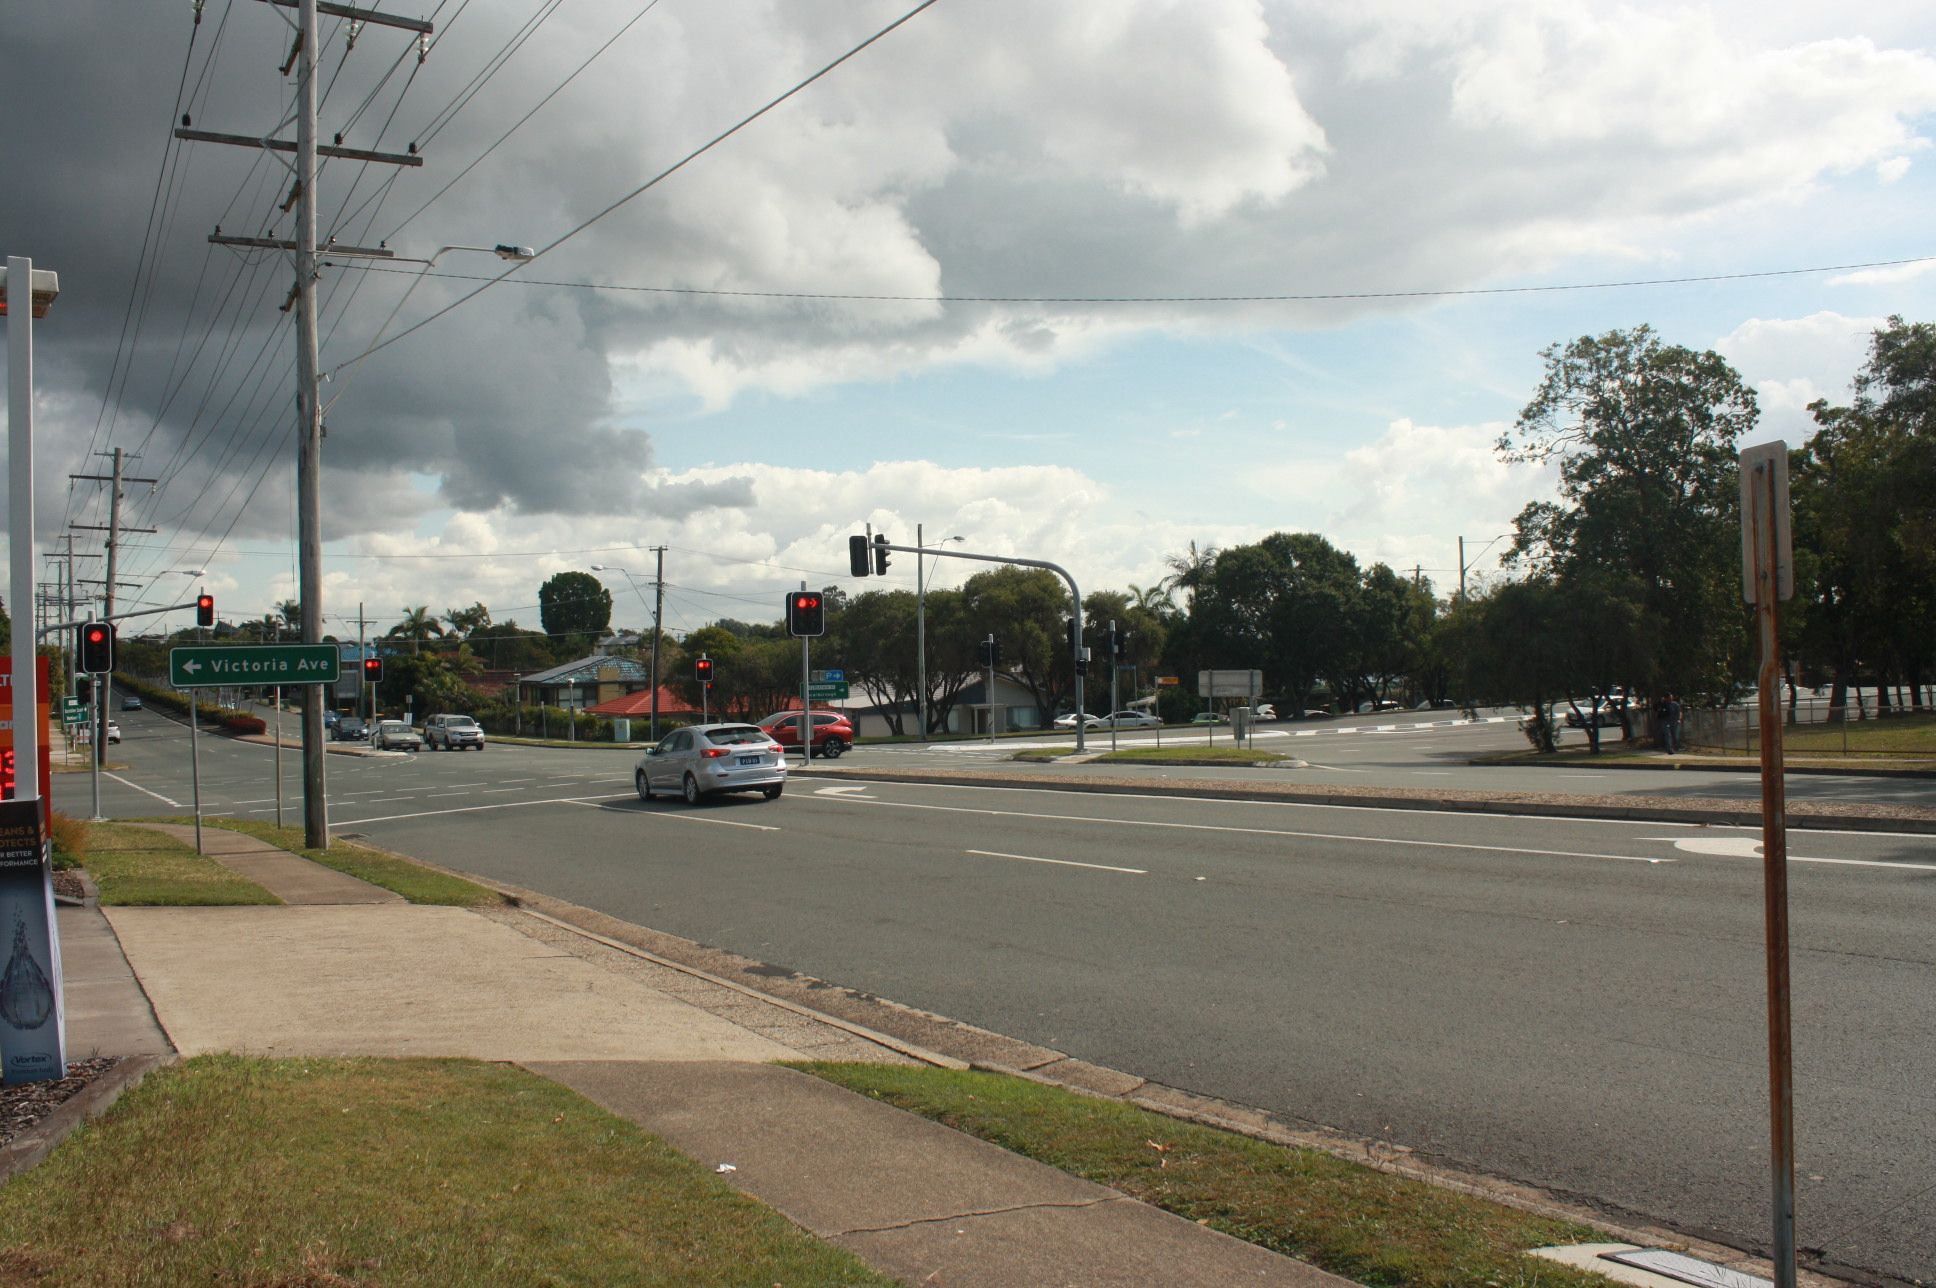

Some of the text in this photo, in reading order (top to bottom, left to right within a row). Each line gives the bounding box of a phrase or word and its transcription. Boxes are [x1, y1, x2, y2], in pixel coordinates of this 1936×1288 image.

[212, 658, 328, 672] Victoria Ave
[6, 850, 32, 858] BETTER
[13, 1055, 47, 1064] Vortex
